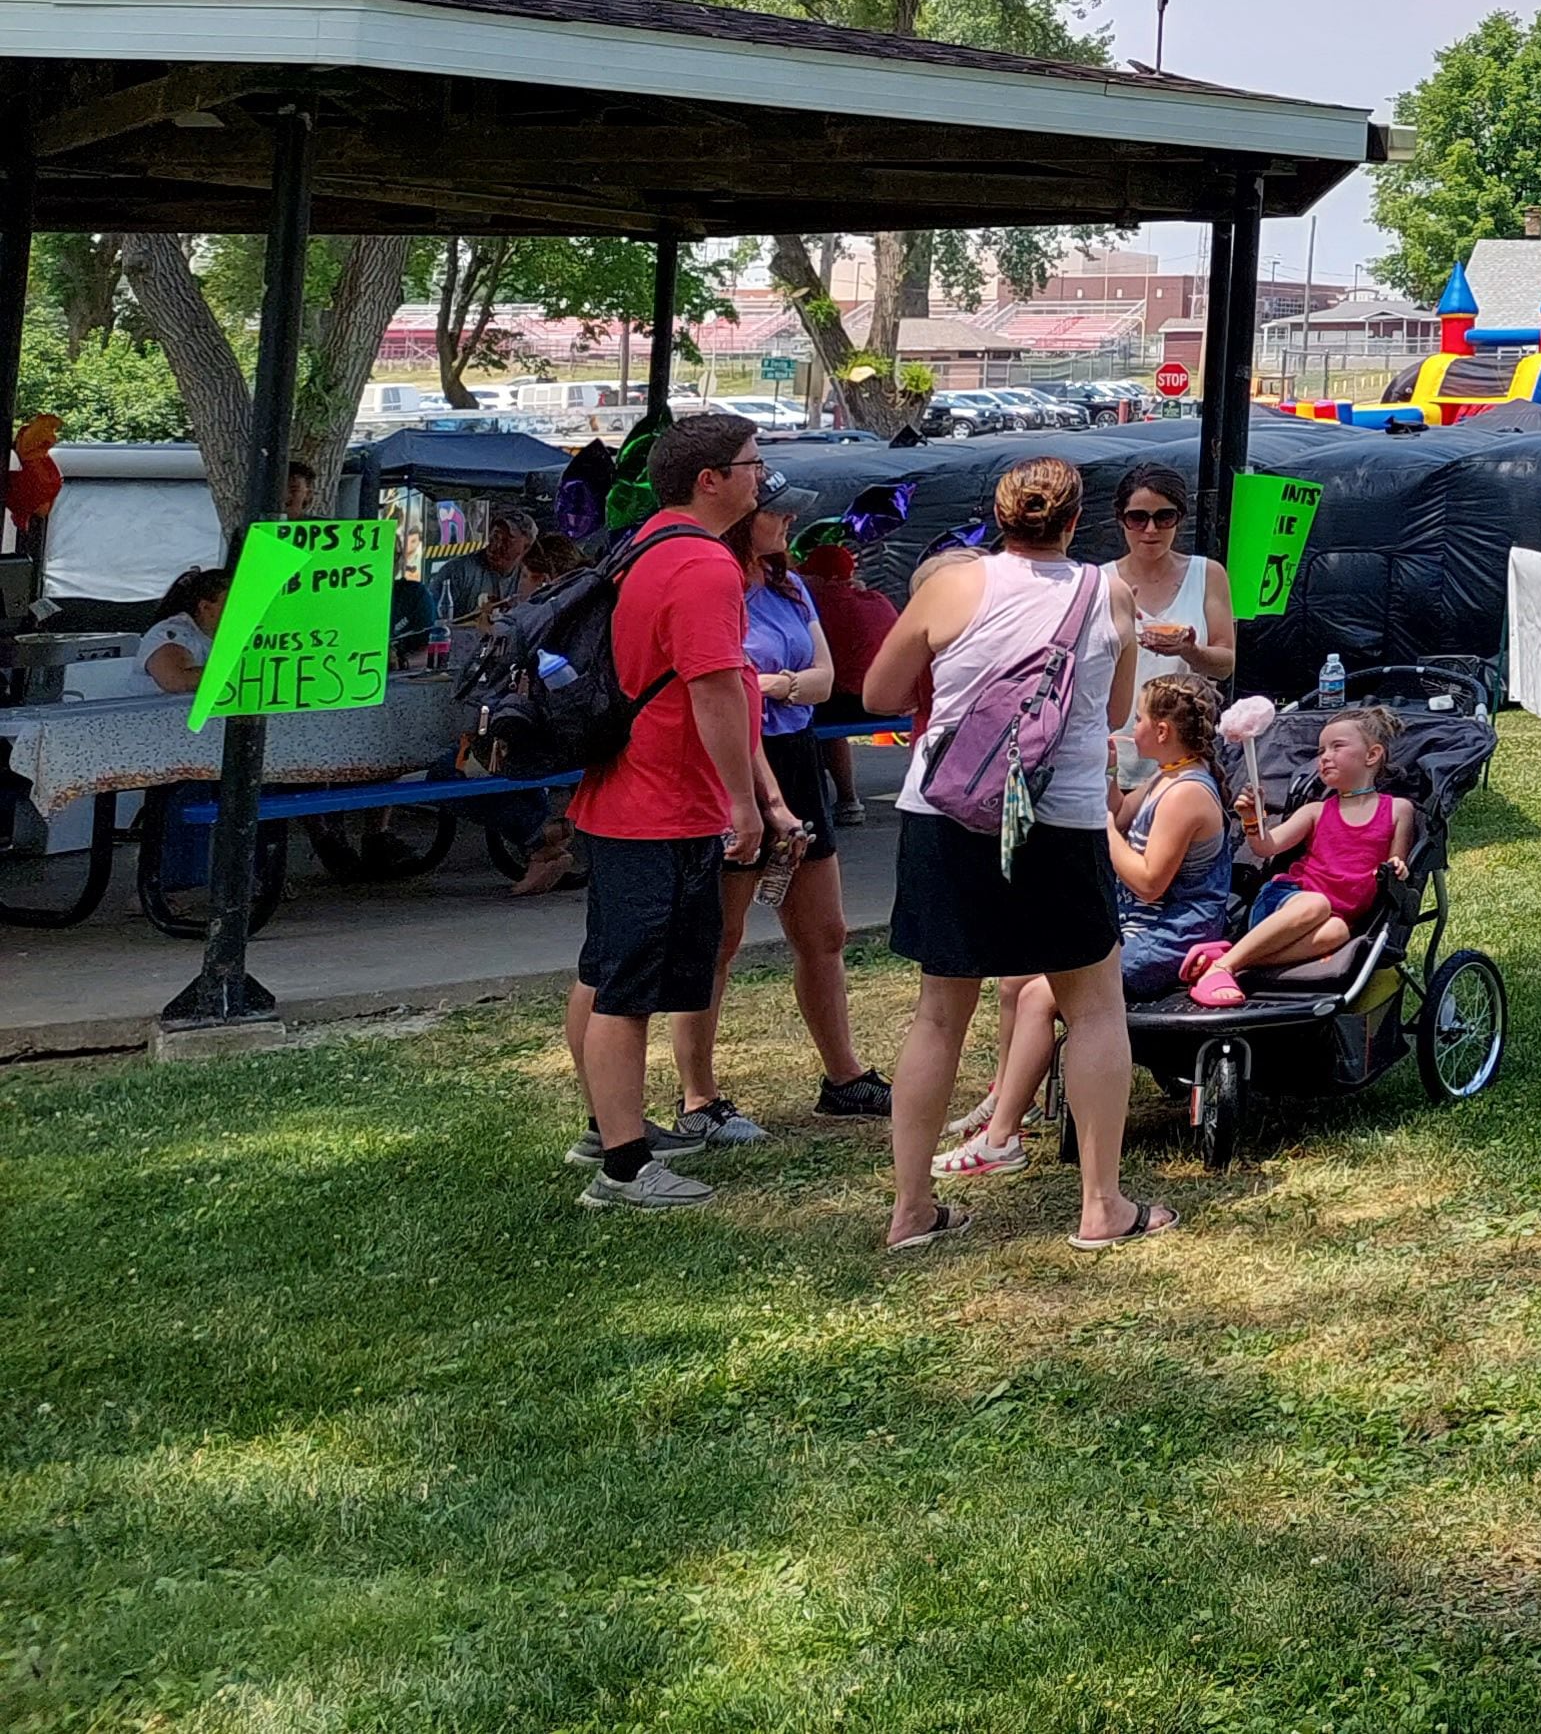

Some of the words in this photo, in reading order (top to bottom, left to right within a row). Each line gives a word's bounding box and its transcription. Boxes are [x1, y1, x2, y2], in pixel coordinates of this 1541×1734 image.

[1157, 372, 1188, 387] STOP
[1281, 483, 1322, 507] INTS
[276, 523, 341, 552] POPS
[351, 523, 381, 553] $1
[1273, 515, 1298, 536] IE
[312, 564, 374, 594] POPS
[244, 625, 304, 652] ONES
